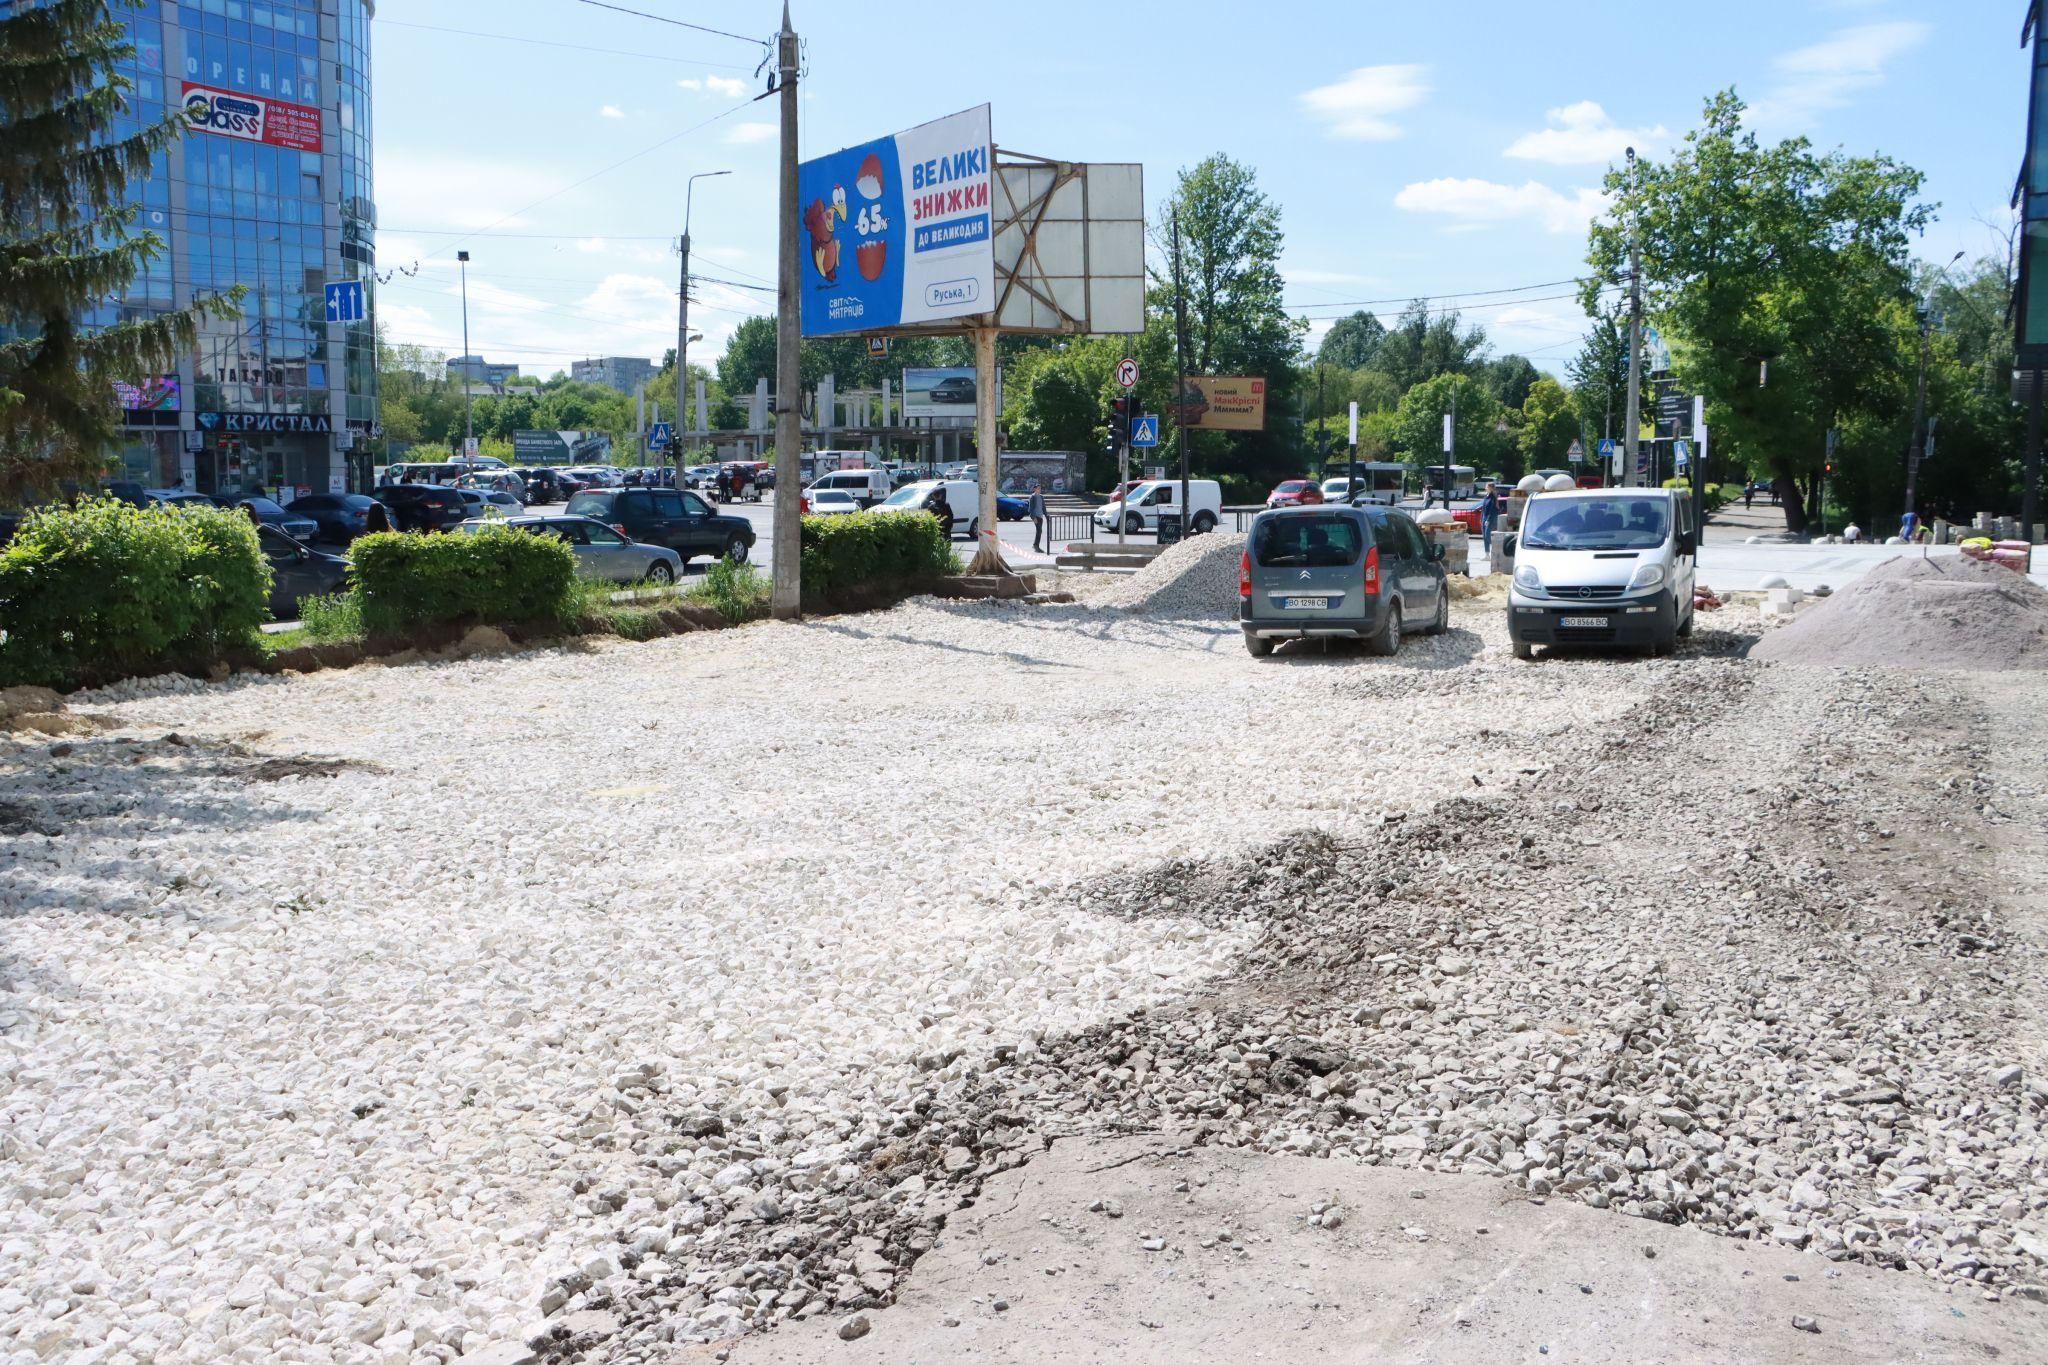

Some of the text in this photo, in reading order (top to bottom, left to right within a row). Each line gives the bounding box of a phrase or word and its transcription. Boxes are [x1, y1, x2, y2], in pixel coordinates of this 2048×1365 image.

[187, 57, 313, 99] ОРЕНДА
[913, 146, 987, 190] ВЕЛИКІ
[913, 182, 988, 221] ЗНИЖКИ
[918, 221, 984, 248] ДО ВЕЛИКОДНЯ
[829, 297, 844, 308] СВІТ
[934, 287, 965, 301] Руська,
[829, 304, 864, 319] МАТРАЦІВ
[225, 414, 330, 432] КРИСТАЛ
